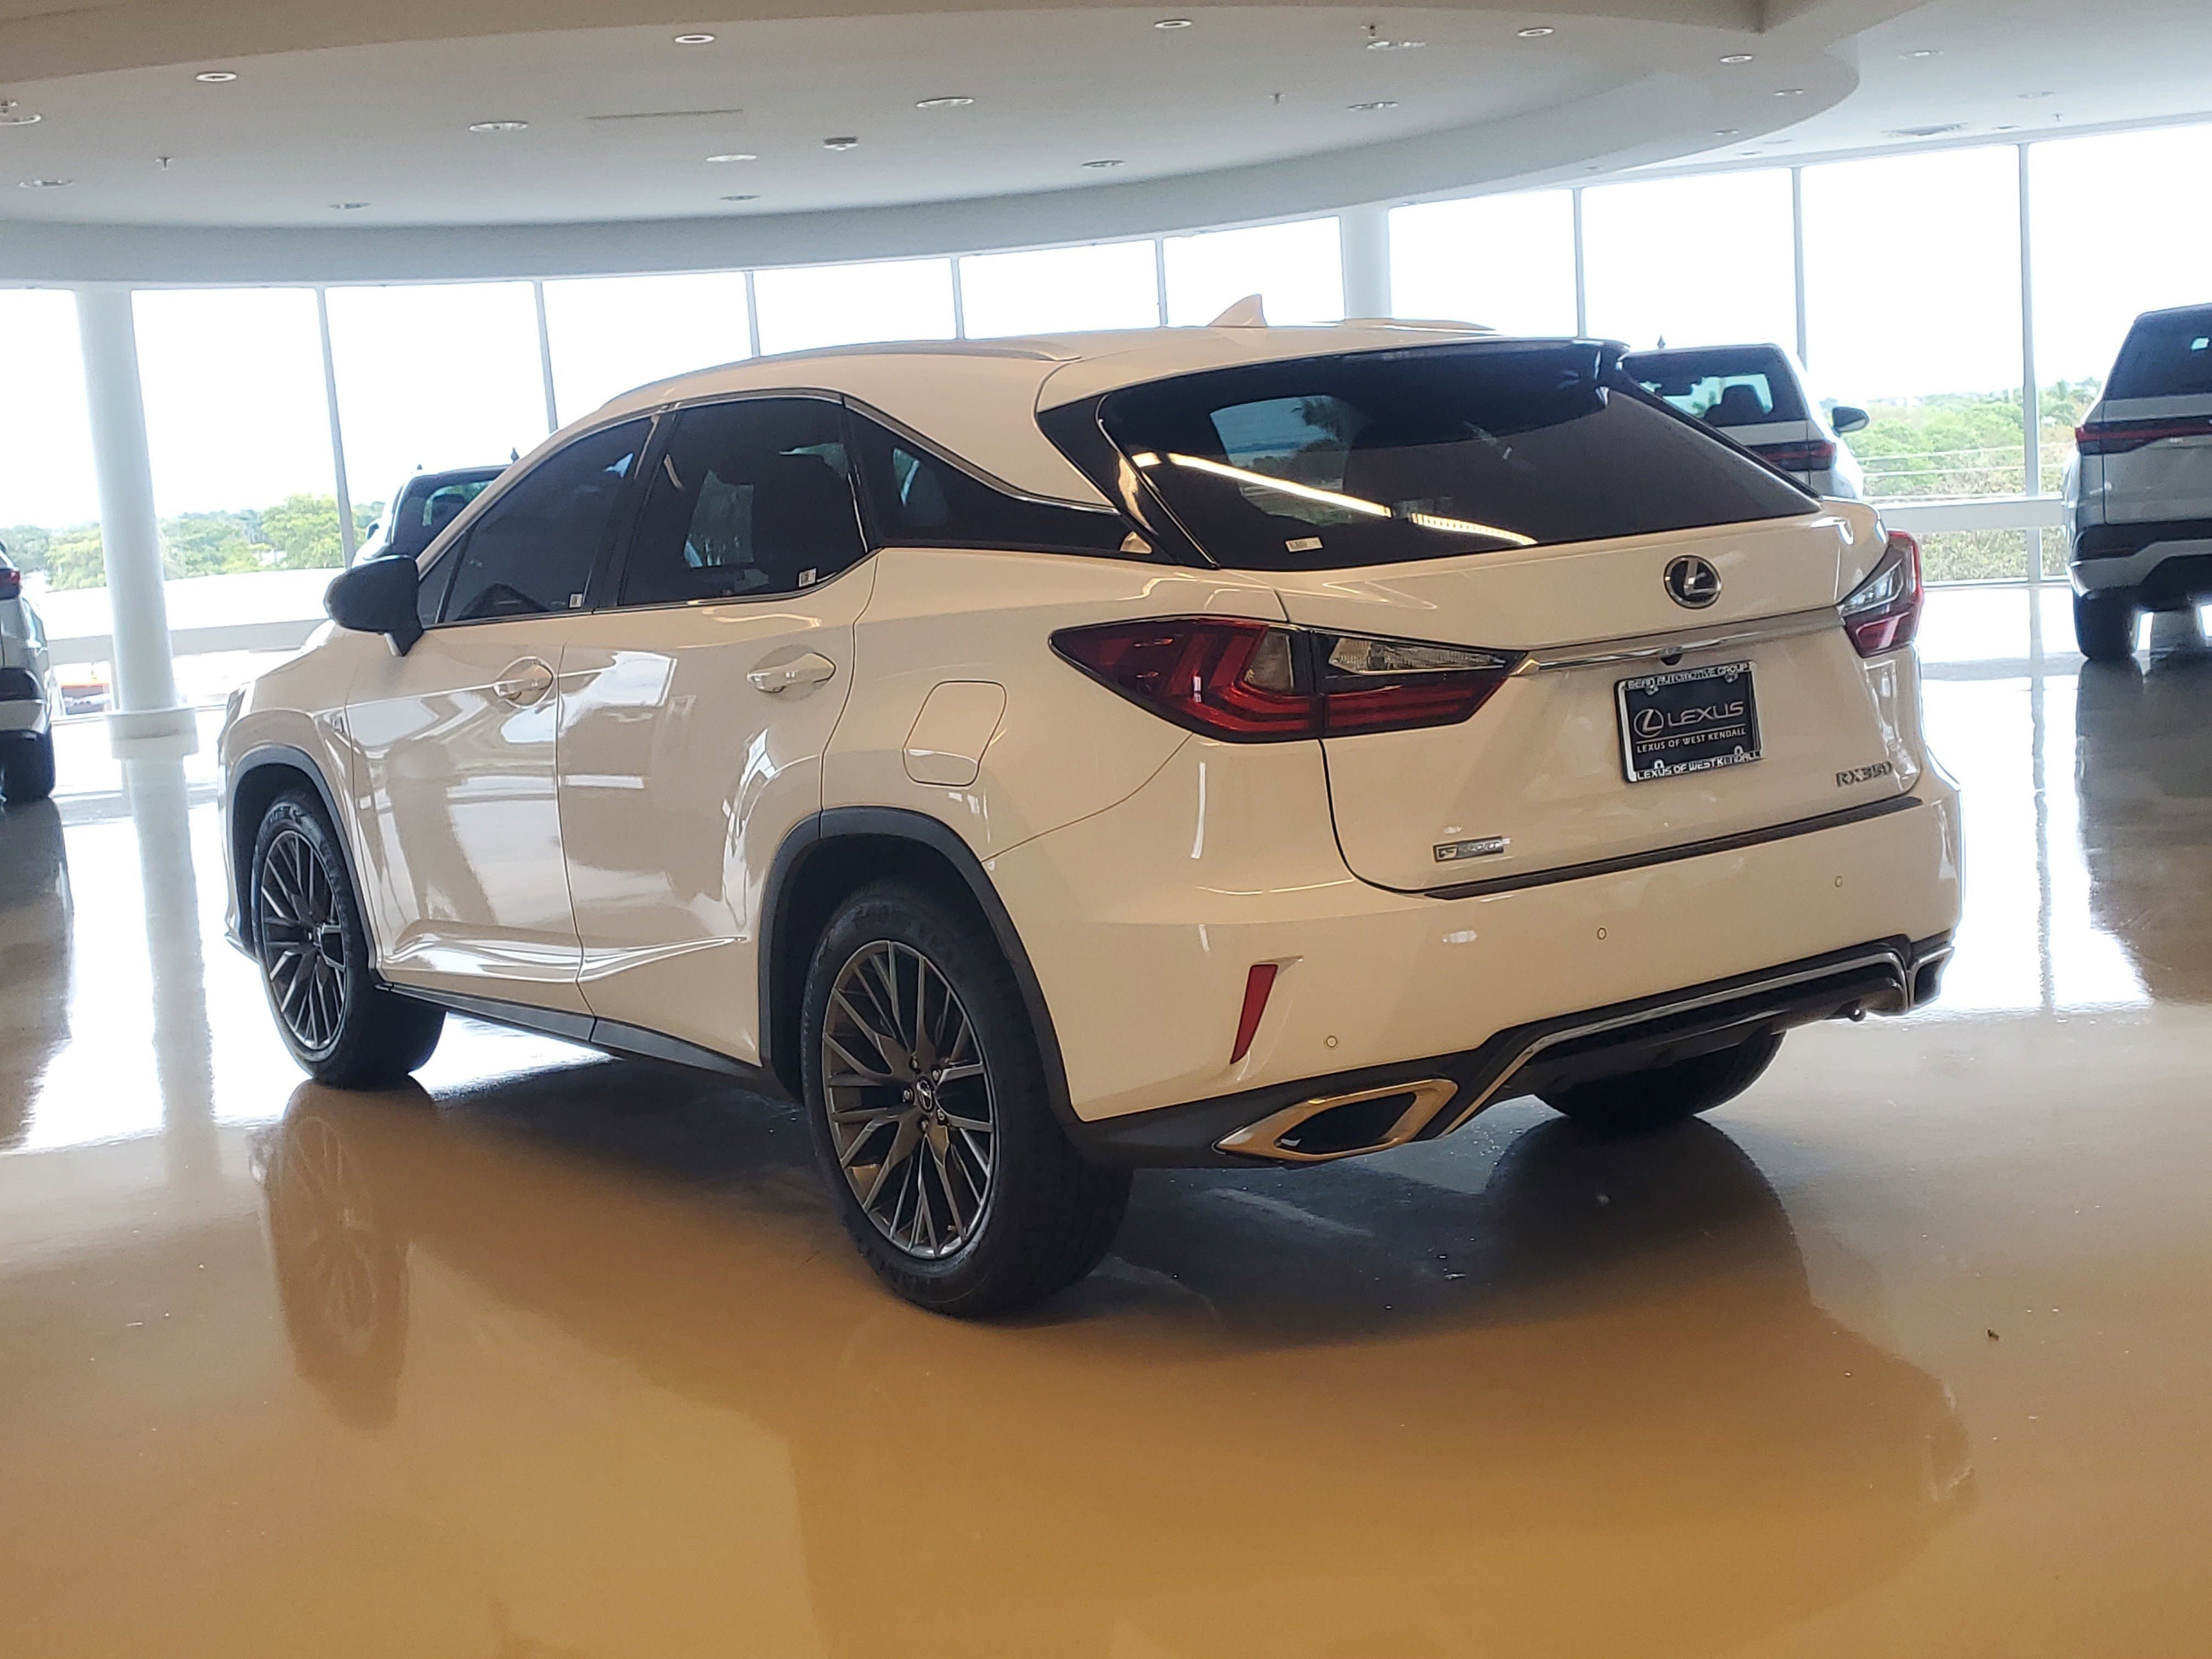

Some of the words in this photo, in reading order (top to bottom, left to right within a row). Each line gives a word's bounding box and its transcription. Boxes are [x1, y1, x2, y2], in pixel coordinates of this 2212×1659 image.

[1717, 663, 1748, 675] GROUP
[1668, 701, 1744, 727] LEXUS
[1637, 742, 1666, 753] LEXUS
[1668, 739, 1680, 749] OF
[1682, 734, 1705, 746] WEST
[1708, 727, 1746, 741] KENDALL
[1637, 766, 1672, 780] LEXUS
[1673, 763, 1688, 775] OF
[1689, 759, 1718, 772] WEST
[1717, 751, 1760, 766] KENDALL
